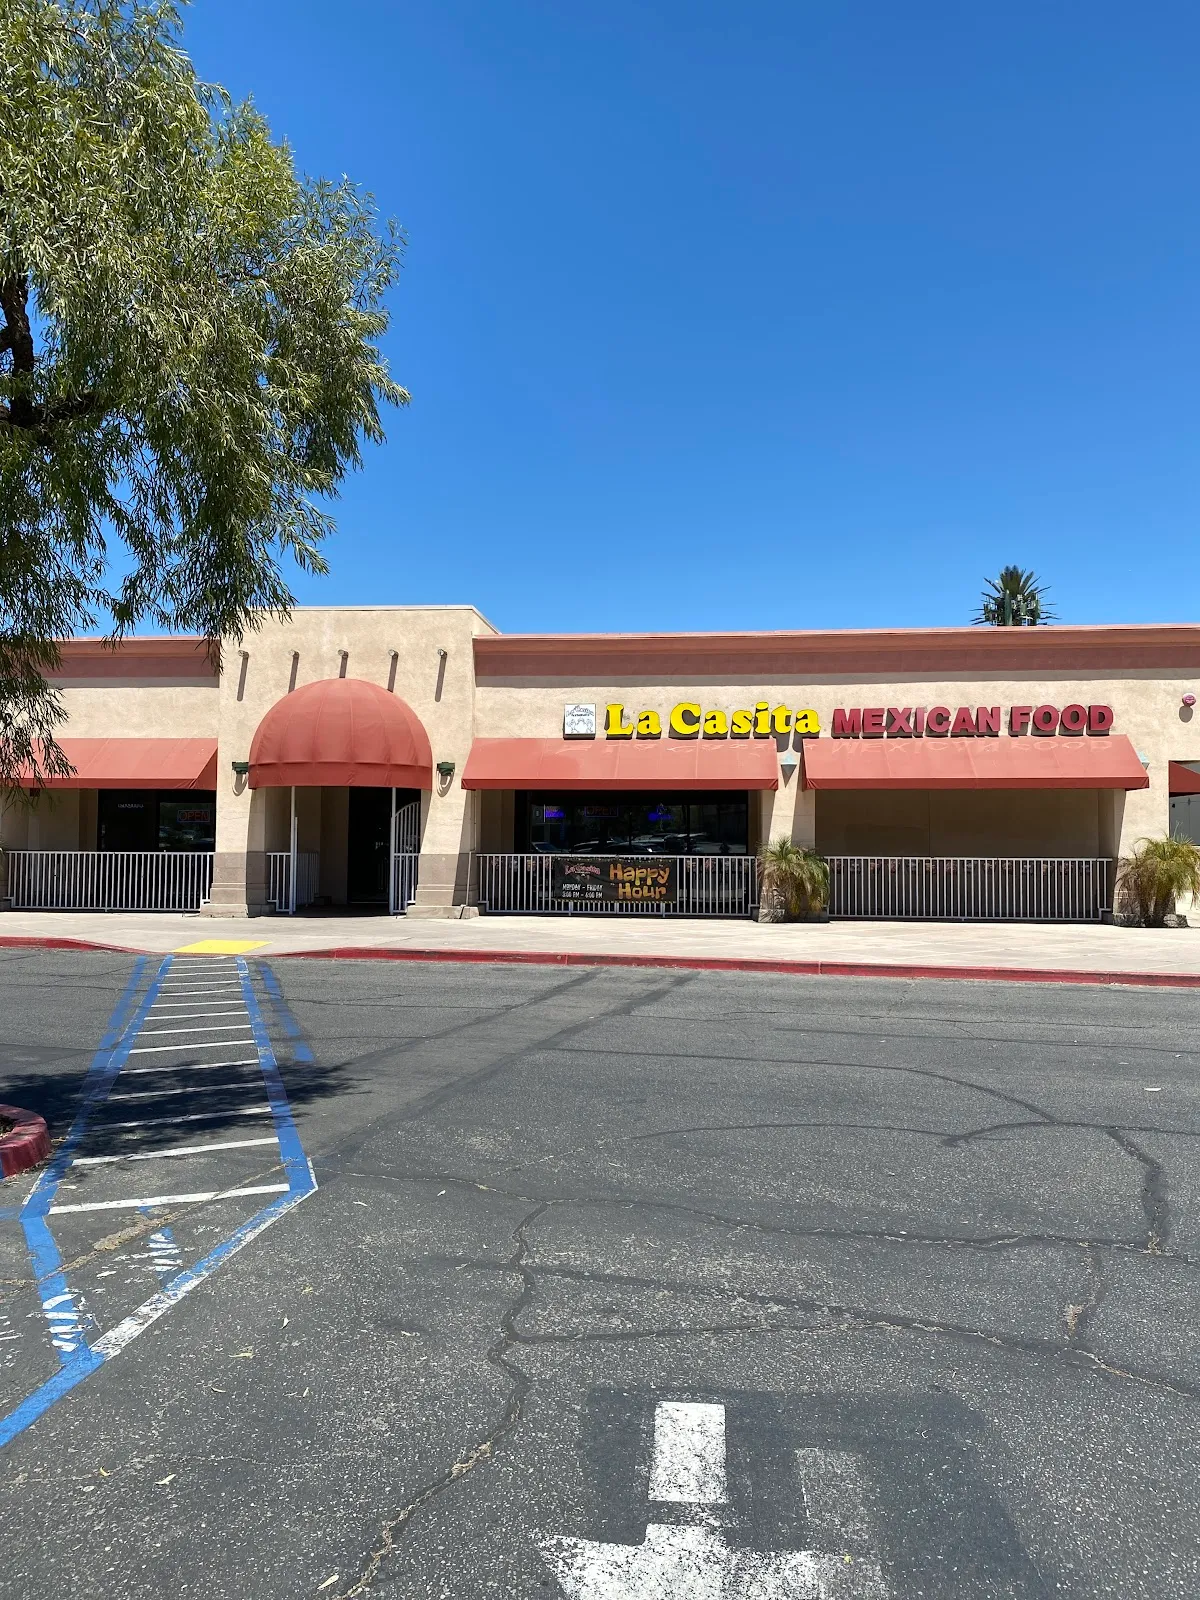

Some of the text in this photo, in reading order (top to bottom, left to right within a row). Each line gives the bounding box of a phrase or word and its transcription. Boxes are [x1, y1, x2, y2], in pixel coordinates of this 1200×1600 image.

[606, 702, 1114, 735] La Casita MEXICAN FOOD
[179, 811, 209, 821] OPEN
[586, 806, 617, 816] OPEN
[609, 863, 670, 885] Happy
[562, 883, 581, 891] MONDAY
[618, 882, 667, 899] Hour
